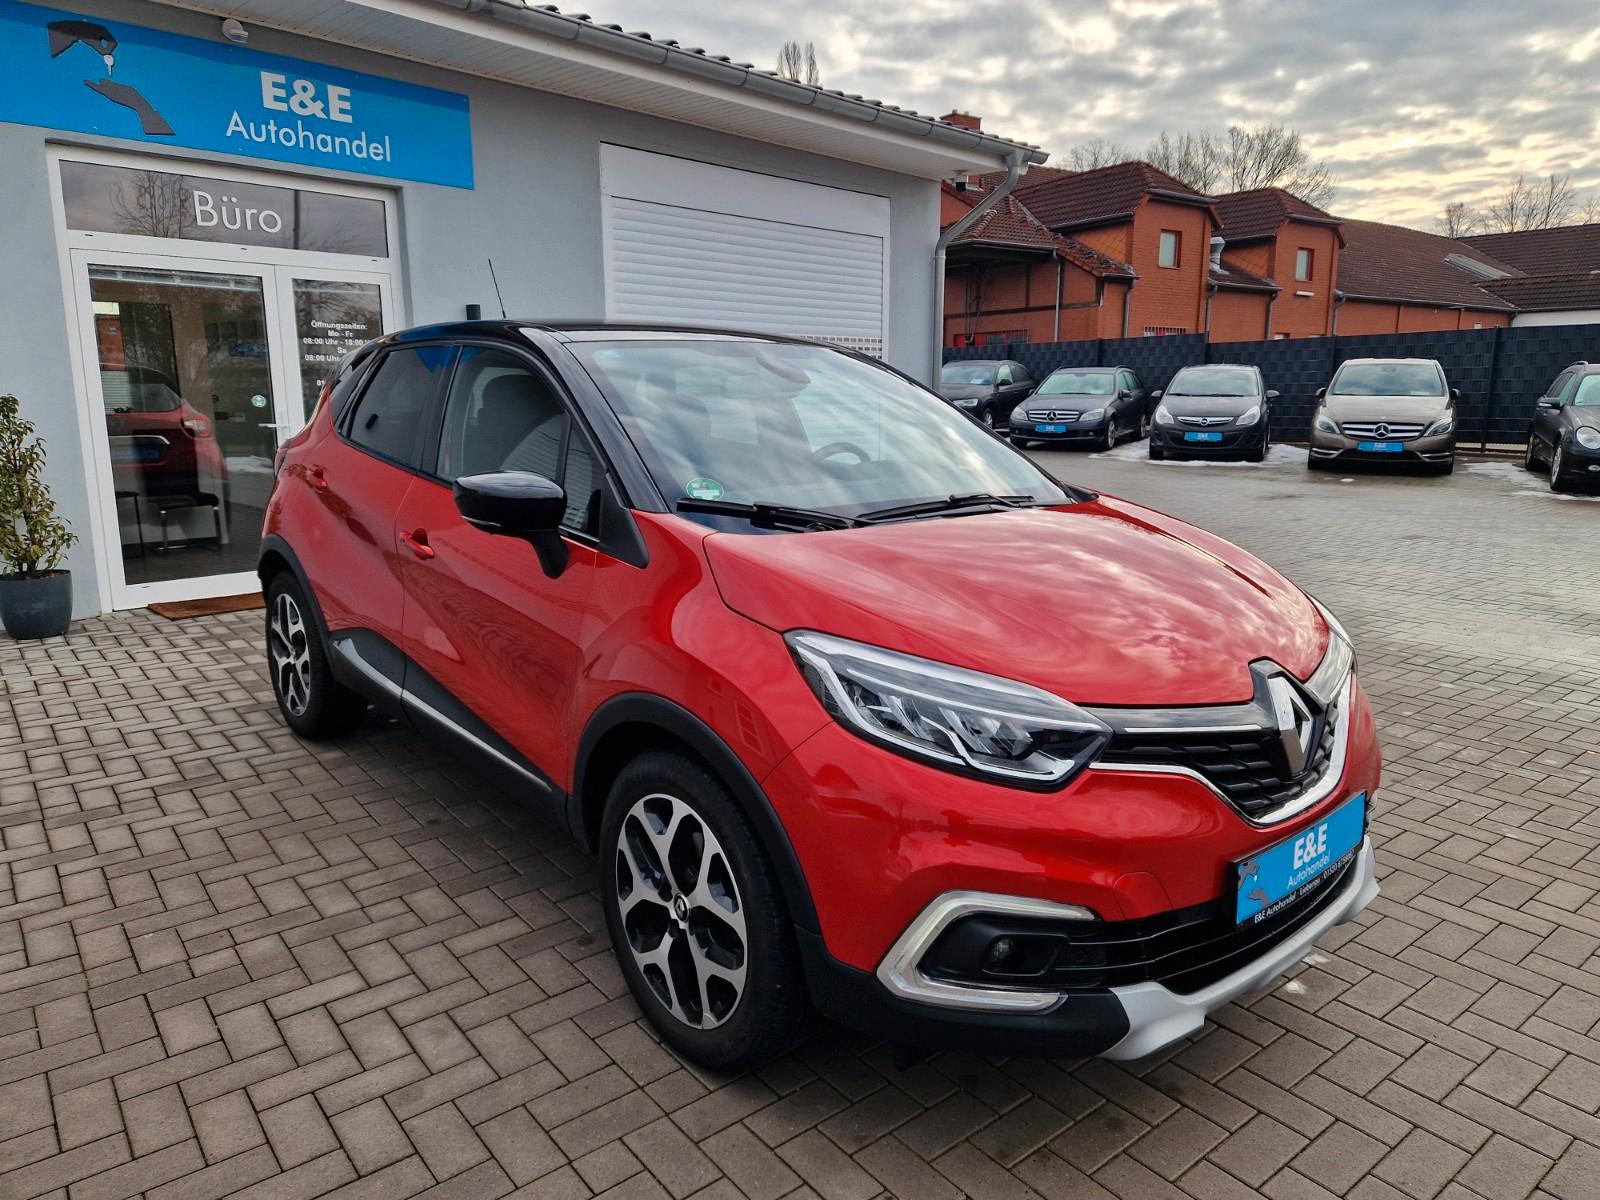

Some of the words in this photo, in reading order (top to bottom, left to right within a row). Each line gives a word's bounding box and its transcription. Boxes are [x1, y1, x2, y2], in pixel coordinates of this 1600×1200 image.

[260, 71, 353, 124] E&E
[225, 110, 391, 162] Autohandel
[193, 190, 282, 233] Büro
[337, 346, 347, 354] Sa
[1293, 823, 1328, 870] E&E
[1287, 850, 1331, 890] Autohandel
